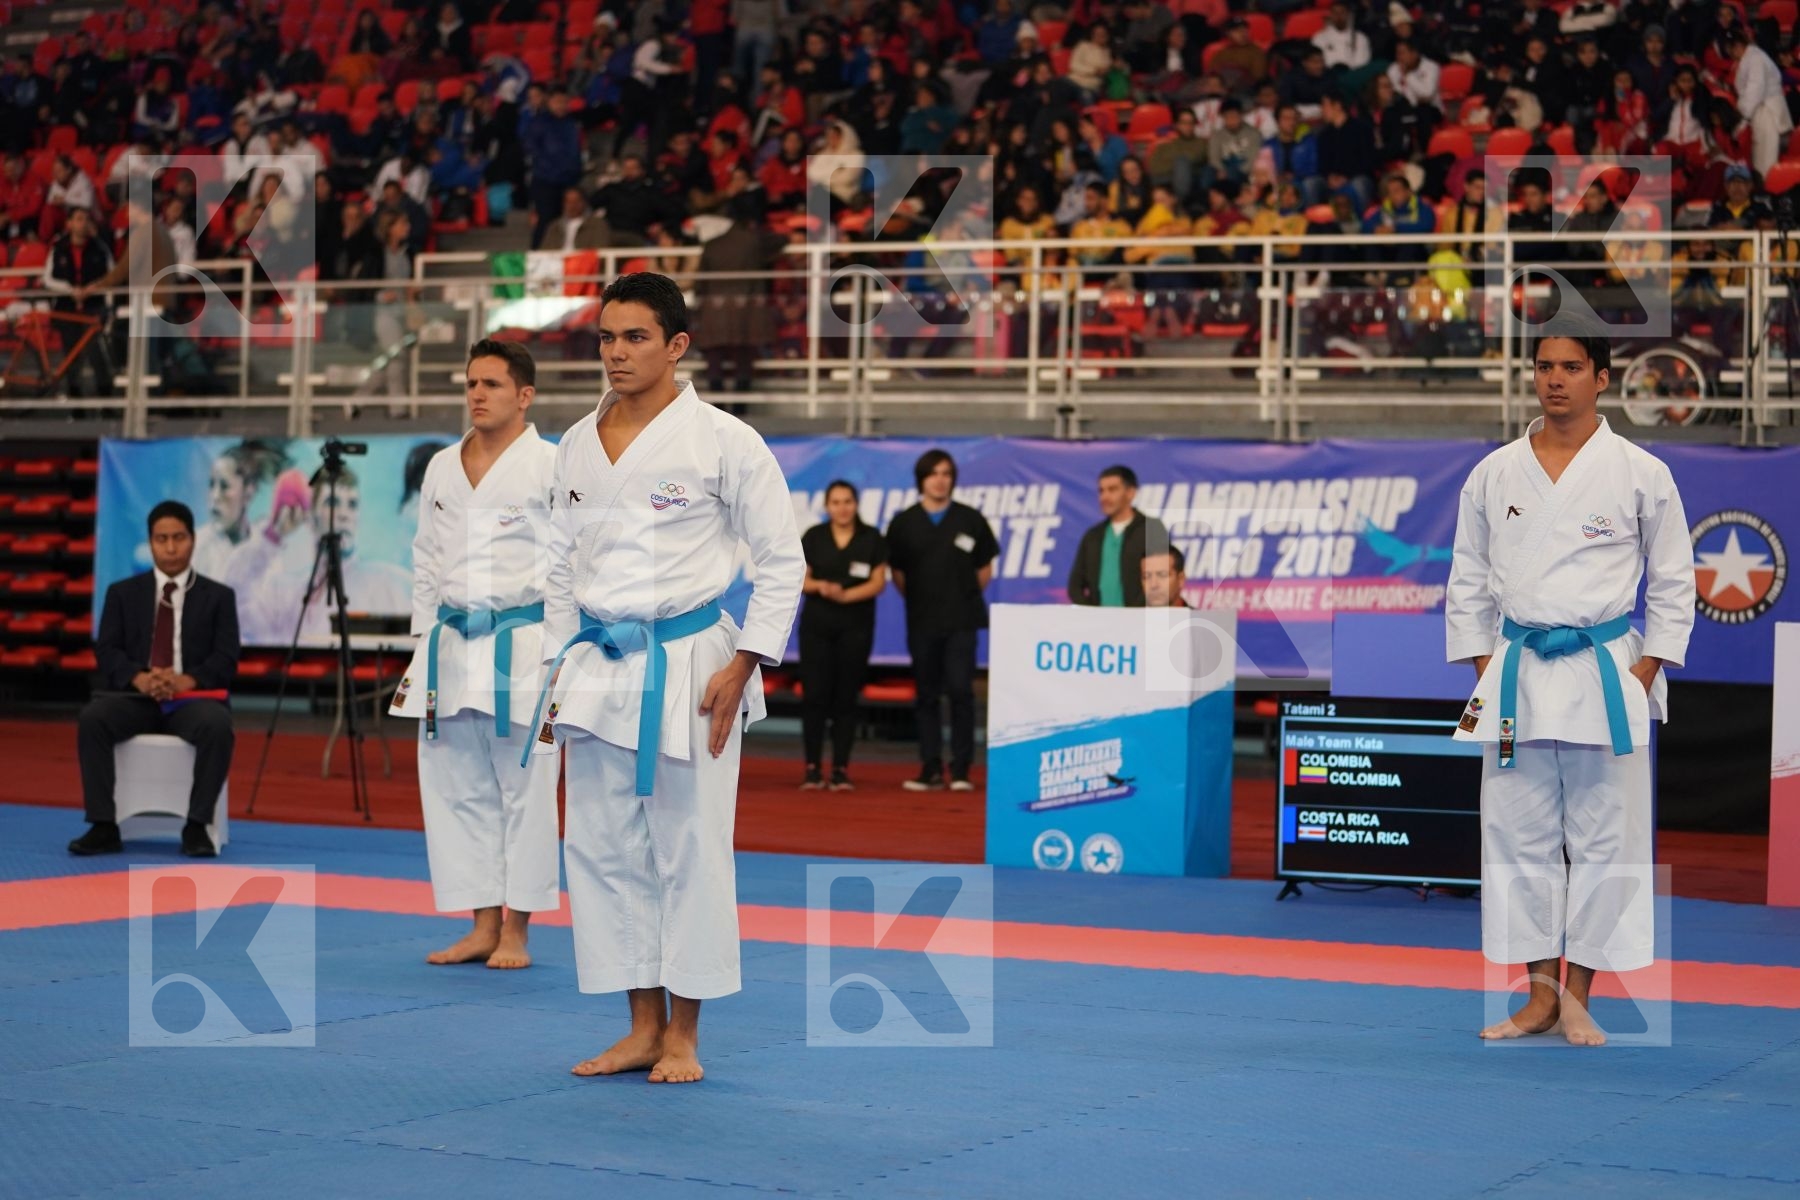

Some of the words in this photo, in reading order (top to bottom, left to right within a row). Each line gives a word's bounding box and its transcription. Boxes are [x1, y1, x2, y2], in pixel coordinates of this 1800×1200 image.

[650, 493, 671, 504] COSTA
[1171, 537, 1264, 579] TIAGO
[1272, 535, 1357, 578] 2018
[1035, 641, 1137, 676] COACH
[1282, 702, 1325, 716] Tatami
[1327, 704, 1337, 717] 2
[1285, 734, 1315, 748] Male
[1317, 736, 1352, 749] Team
[1354, 737, 1384, 750] Kata
[1300, 754, 1372, 768] COLOMBIA
[1329, 771, 1402, 787] COLOMBIA
[1299, 811, 1345, 826] COSTA
[1347, 812, 1380, 827] RICA
[1328, 830, 1375, 845] COSTA
[1376, 831, 1410, 846] RICA
